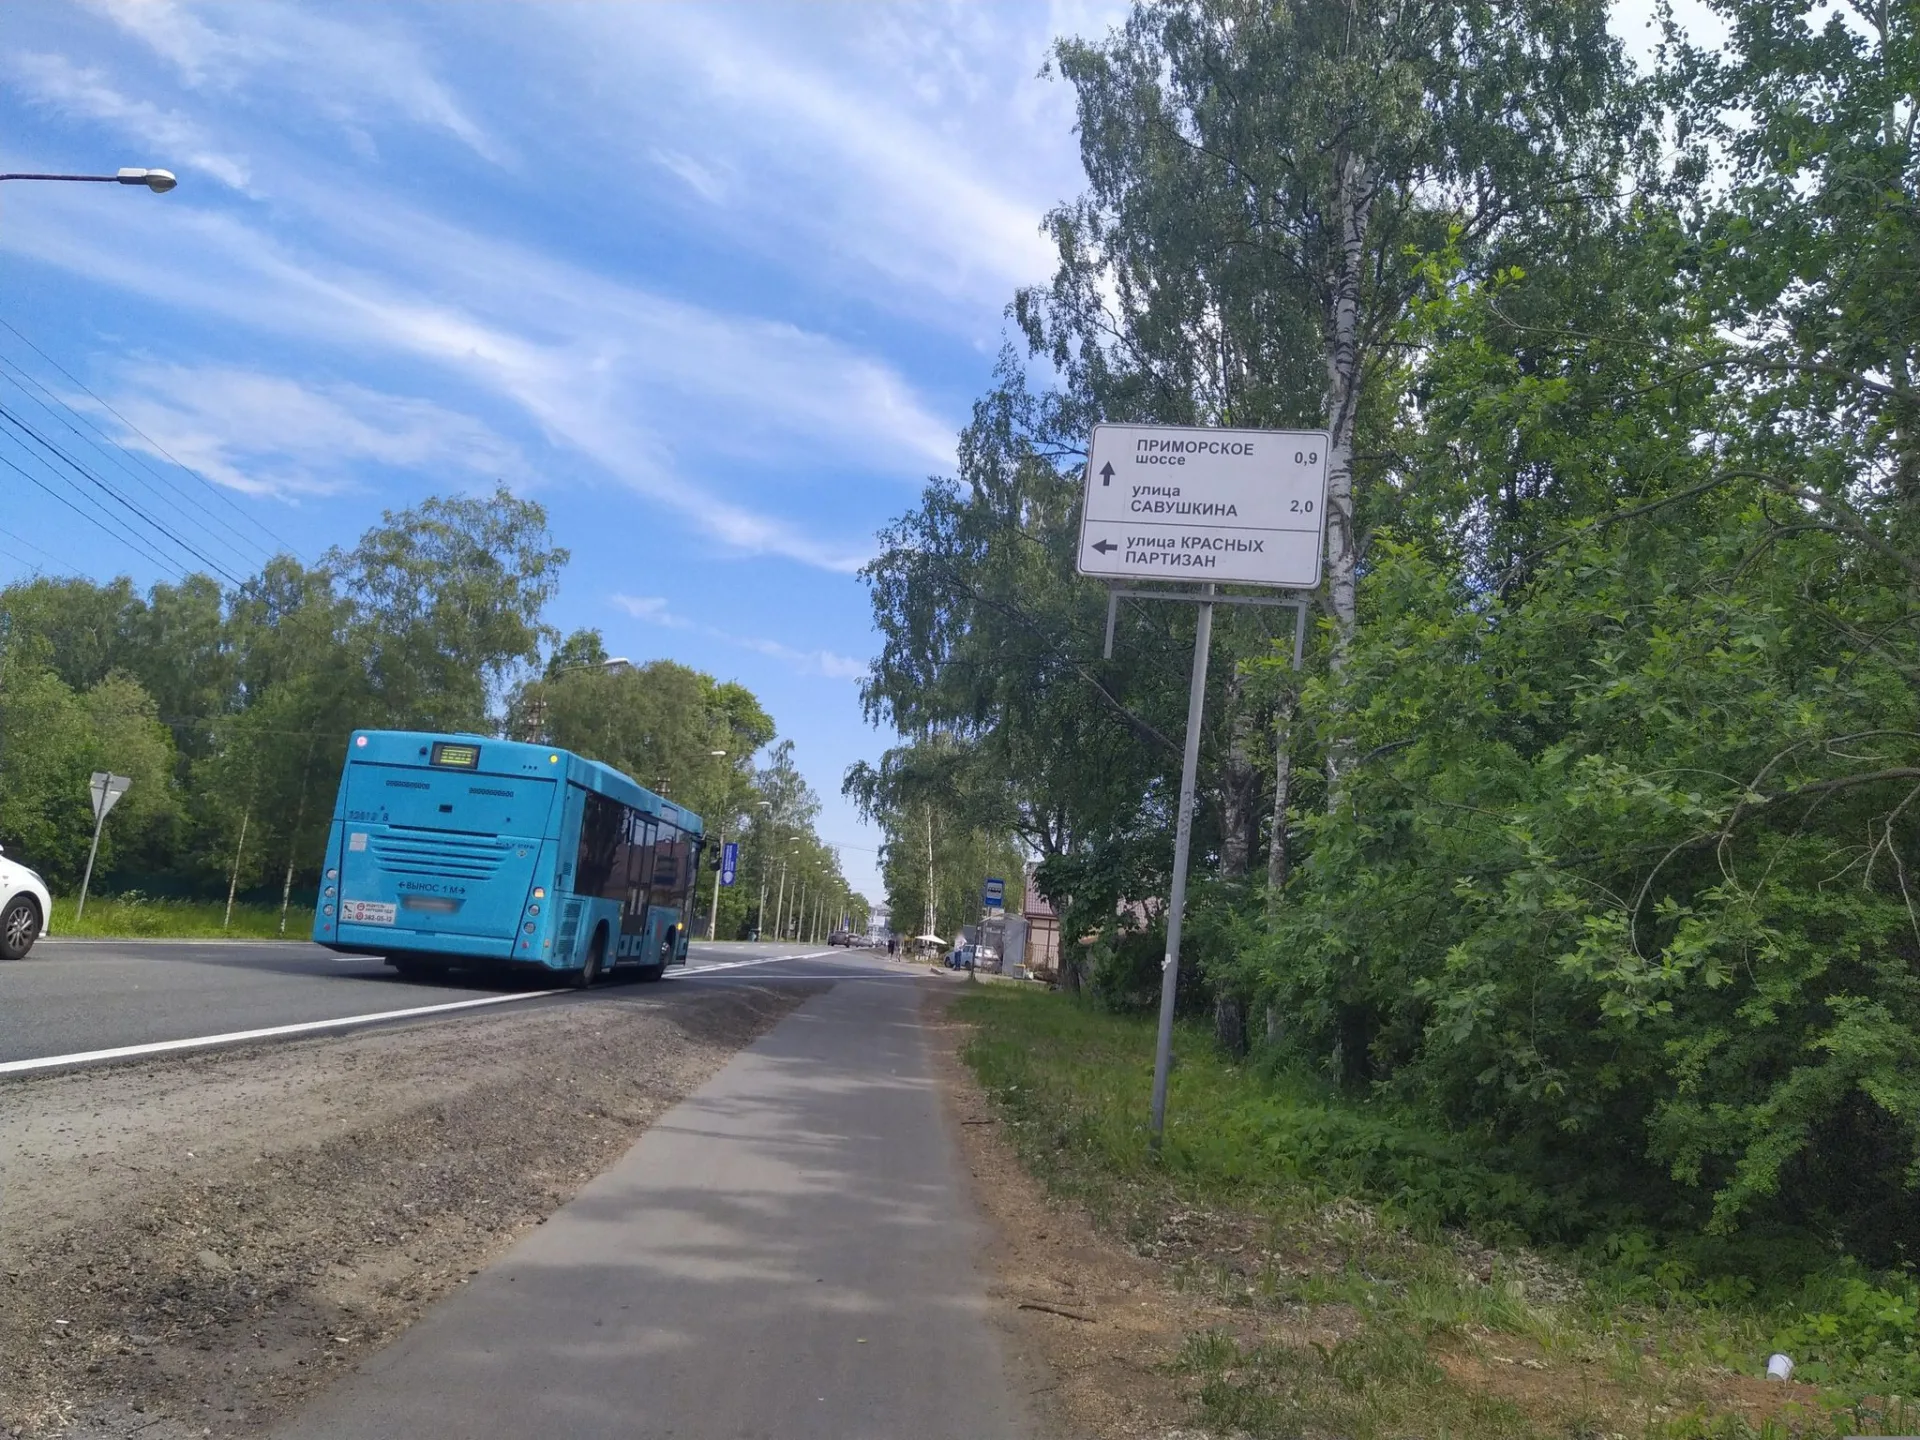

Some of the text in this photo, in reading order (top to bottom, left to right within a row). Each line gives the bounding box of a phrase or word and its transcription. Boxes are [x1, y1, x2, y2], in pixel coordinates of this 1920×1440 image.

[1136, 439, 1255, 456] ПРИМОРСКОЕ
[1135, 455, 1186, 466] шоссе
[1294, 451, 1318, 466] 0,9
[1131, 485, 1181, 498] улица
[1130, 499, 1238, 517] САВУШКИНА
[1289, 499, 1314, 515] 2,0
[1126, 536, 1265, 553] улица КРАСНЫХ
[1125, 551, 1216, 568] ПАРТИЗАН
[406, 881, 440, 892] ВЫНОС
